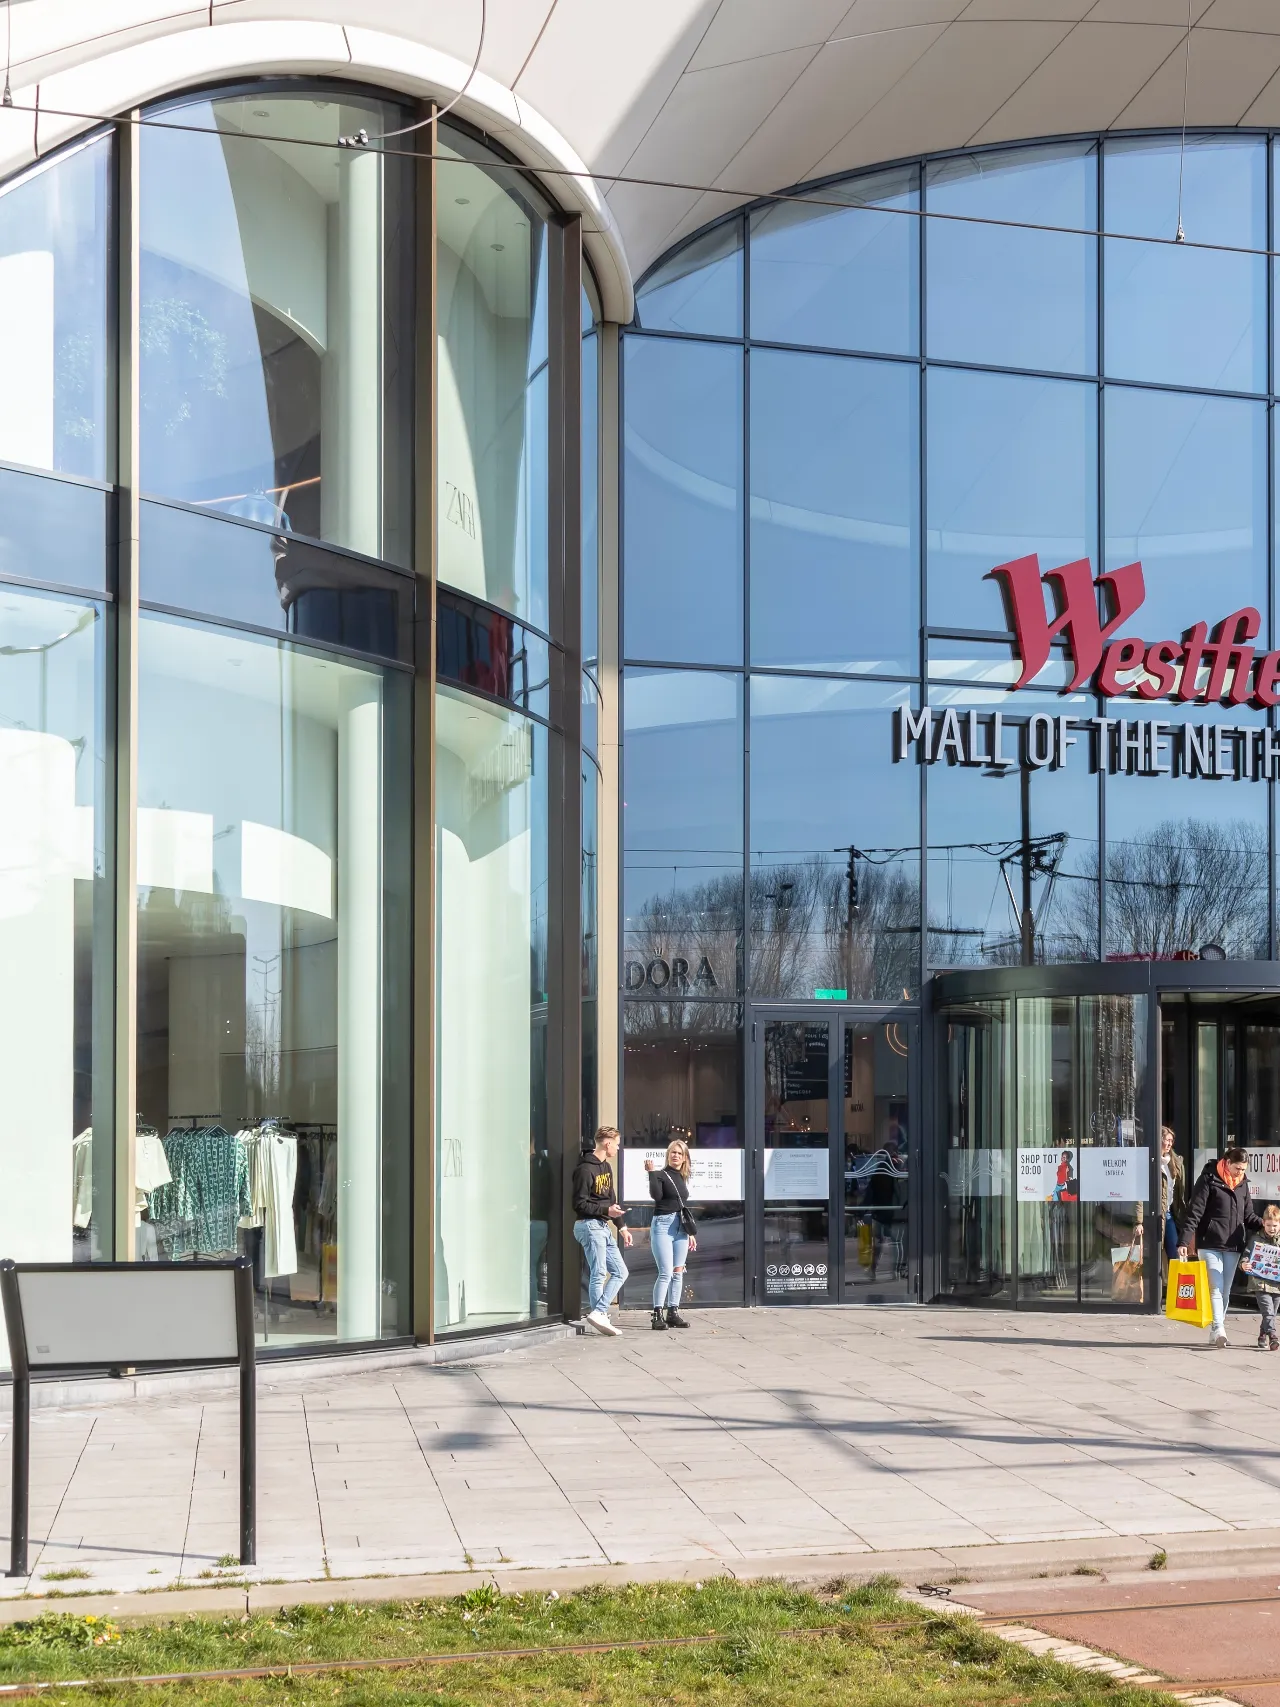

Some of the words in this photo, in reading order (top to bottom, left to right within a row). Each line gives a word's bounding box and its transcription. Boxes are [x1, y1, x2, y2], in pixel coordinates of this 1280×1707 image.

[897, 706, 1014, 766] MALL
[1027, 712, 1077, 768] OF
[1091, 717, 1171, 773] THE
[1020, 1154, 1040, 1164] SHOP
[1043, 1153, 1058, 1164] TOT
[1102, 1159, 1127, 1168] WELKOM
[1249, 1153, 1264, 1173] TOT
[1020, 1165, 1042, 1175] 20:00
